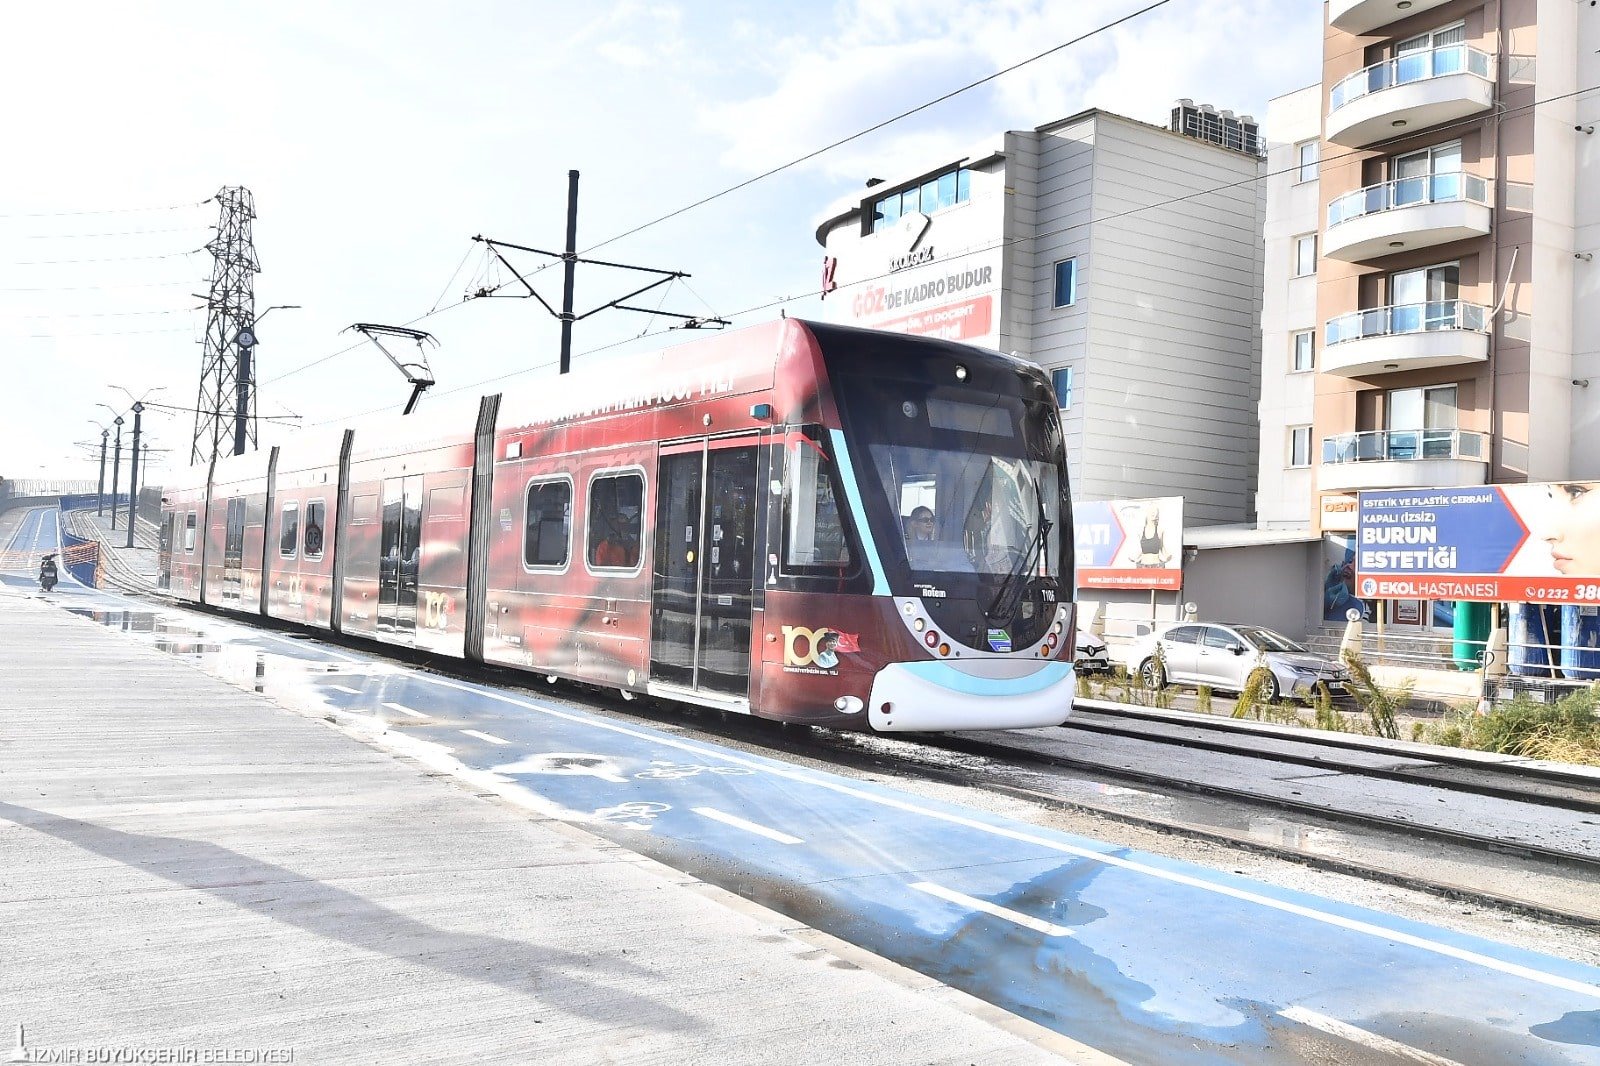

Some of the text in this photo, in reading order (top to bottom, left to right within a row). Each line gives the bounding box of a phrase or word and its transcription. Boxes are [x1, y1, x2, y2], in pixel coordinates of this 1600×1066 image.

[904, 279, 946, 306] KADRO
[947, 265, 993, 295] BUDUR
[1363, 493, 1492, 507] ESTETİK VE PLASTİK CERRAHİ
[1363, 510, 1436, 523] KAPALI (İZSİZ)
[1362, 526, 1437, 544] BURUN
[1362, 545, 1457, 569] ESTETİĞİ
[922, 586, 947, 598] Rotem
[1042, 589, 1055, 602] T106
[1537, 588, 1545, 599] 0
[1547, 588, 1569, 599] 232
